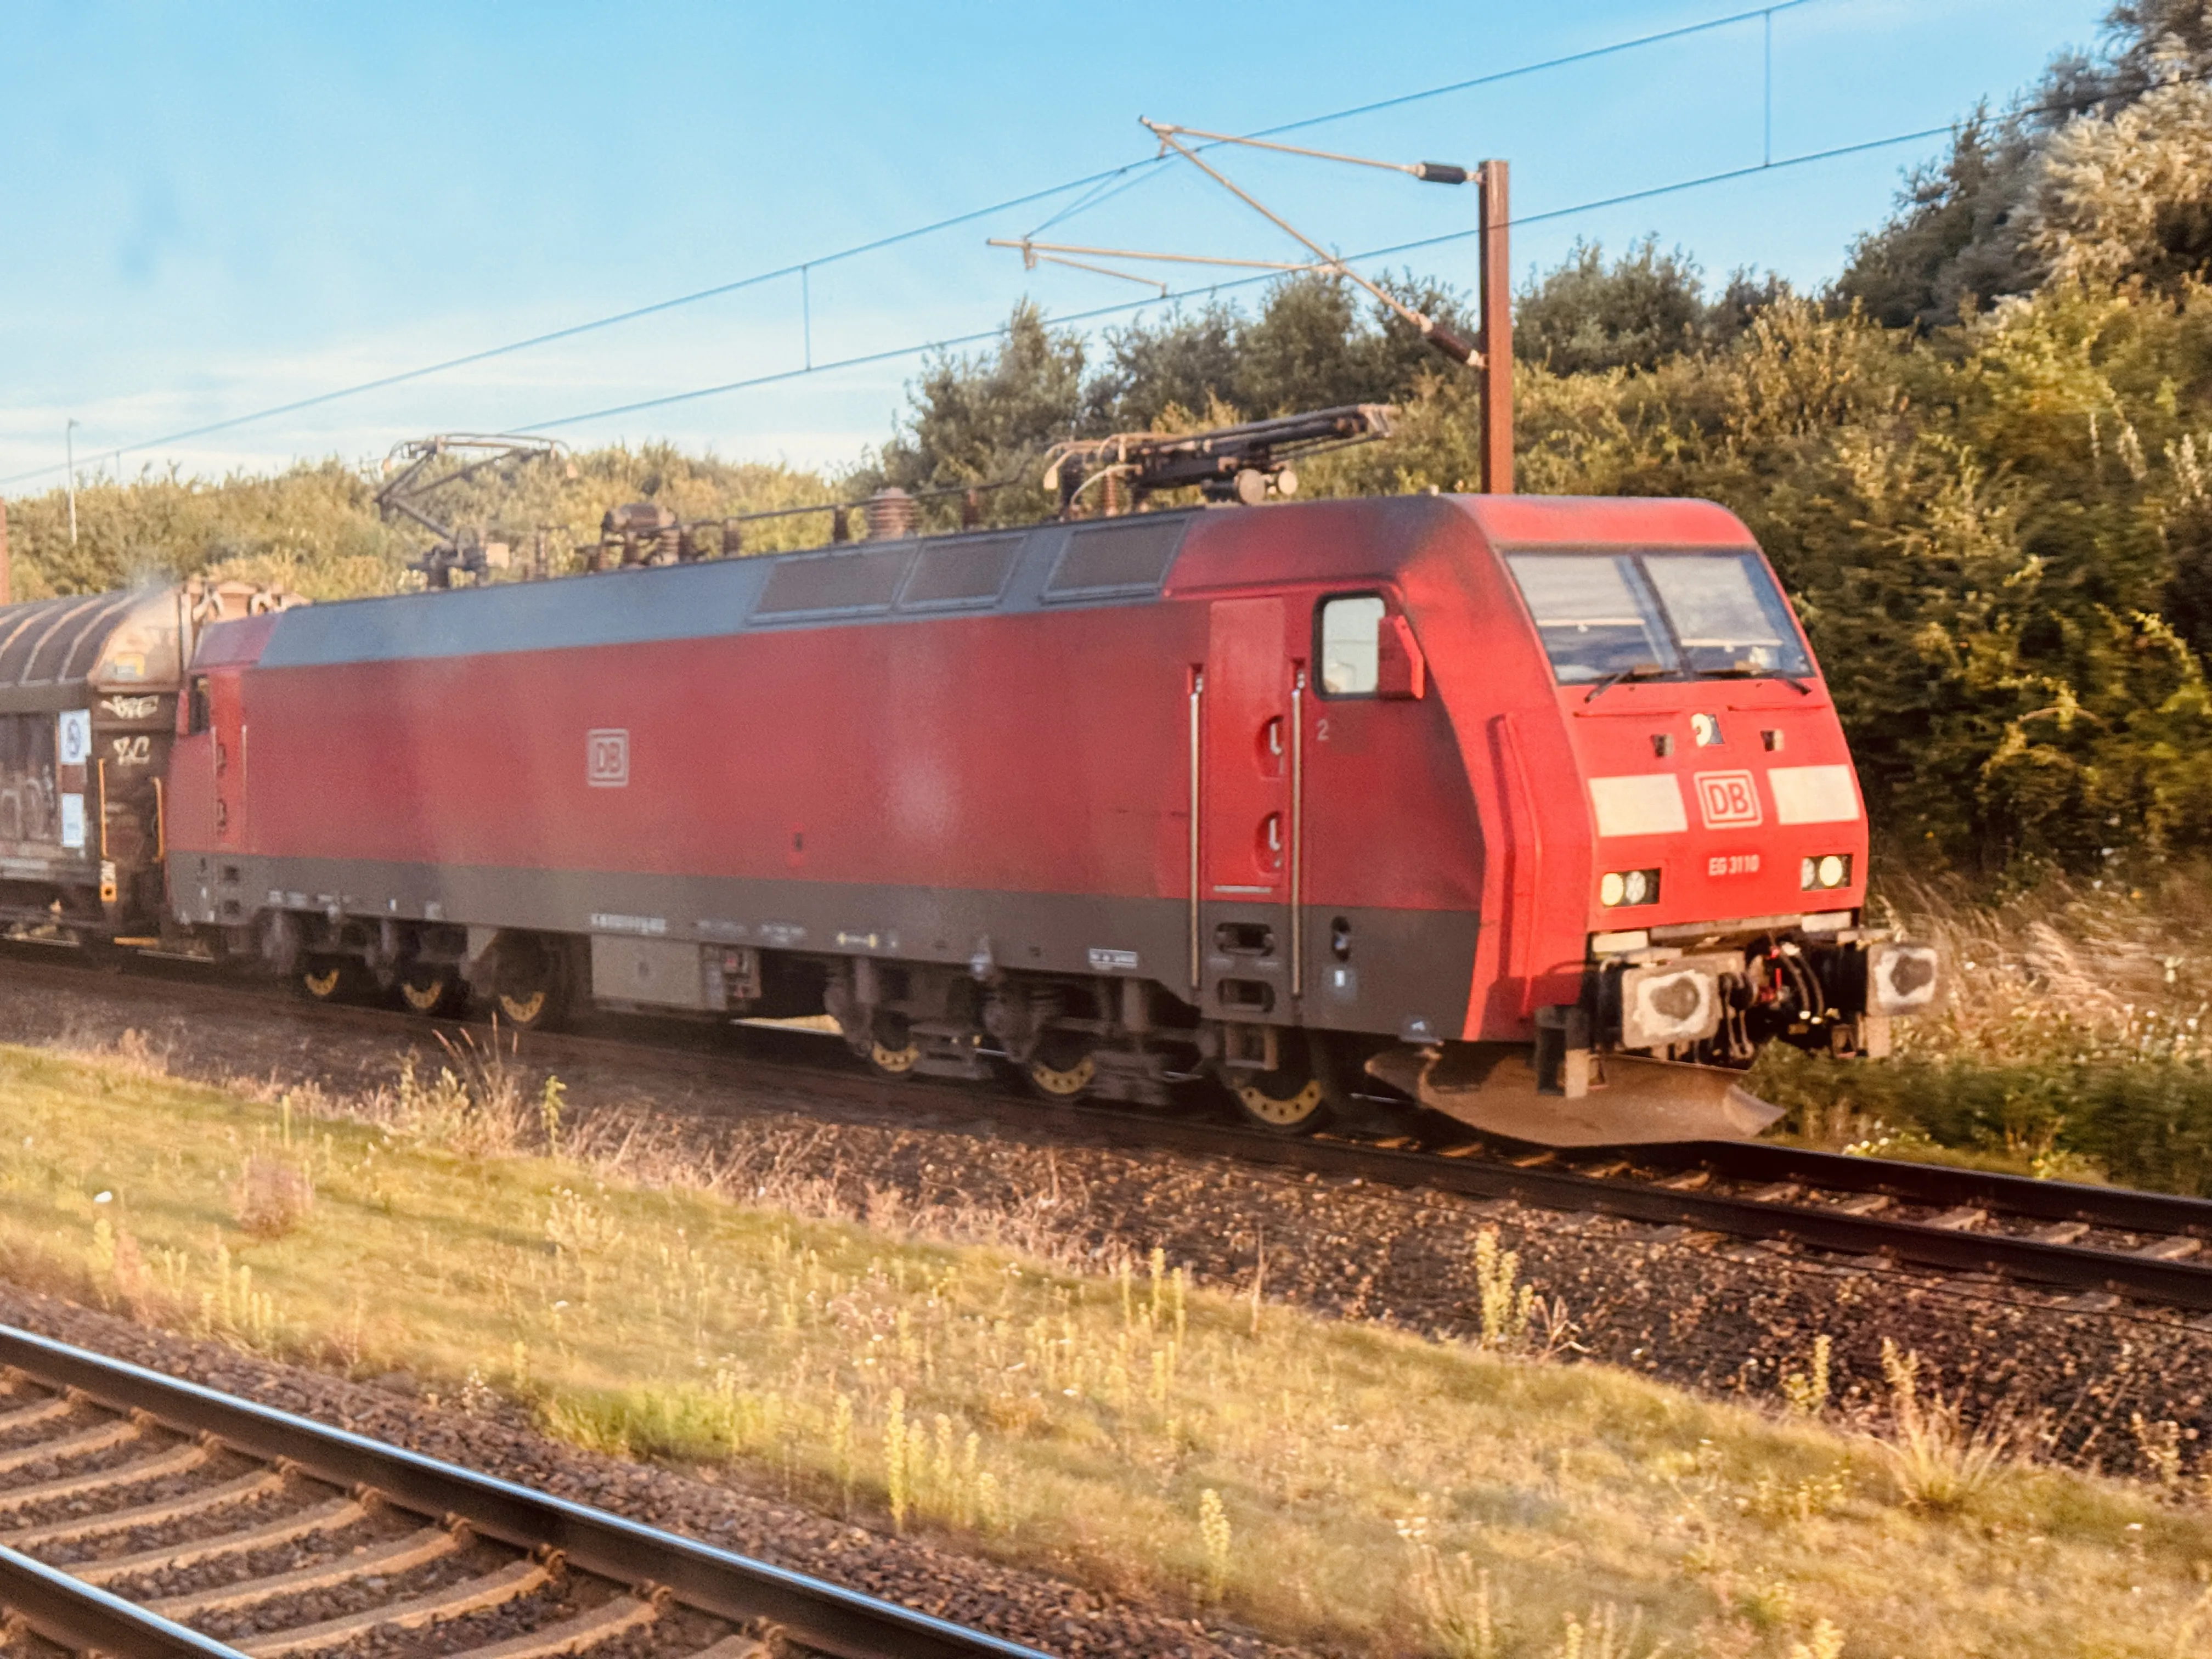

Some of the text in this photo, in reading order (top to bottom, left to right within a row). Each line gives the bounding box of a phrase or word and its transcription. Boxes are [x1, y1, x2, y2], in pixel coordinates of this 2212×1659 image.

[1317, 719, 1329, 741] 2
[596, 742, 620, 773] DB
[1708, 780, 1749, 815] DB
[1708, 857, 1727, 876] EG
